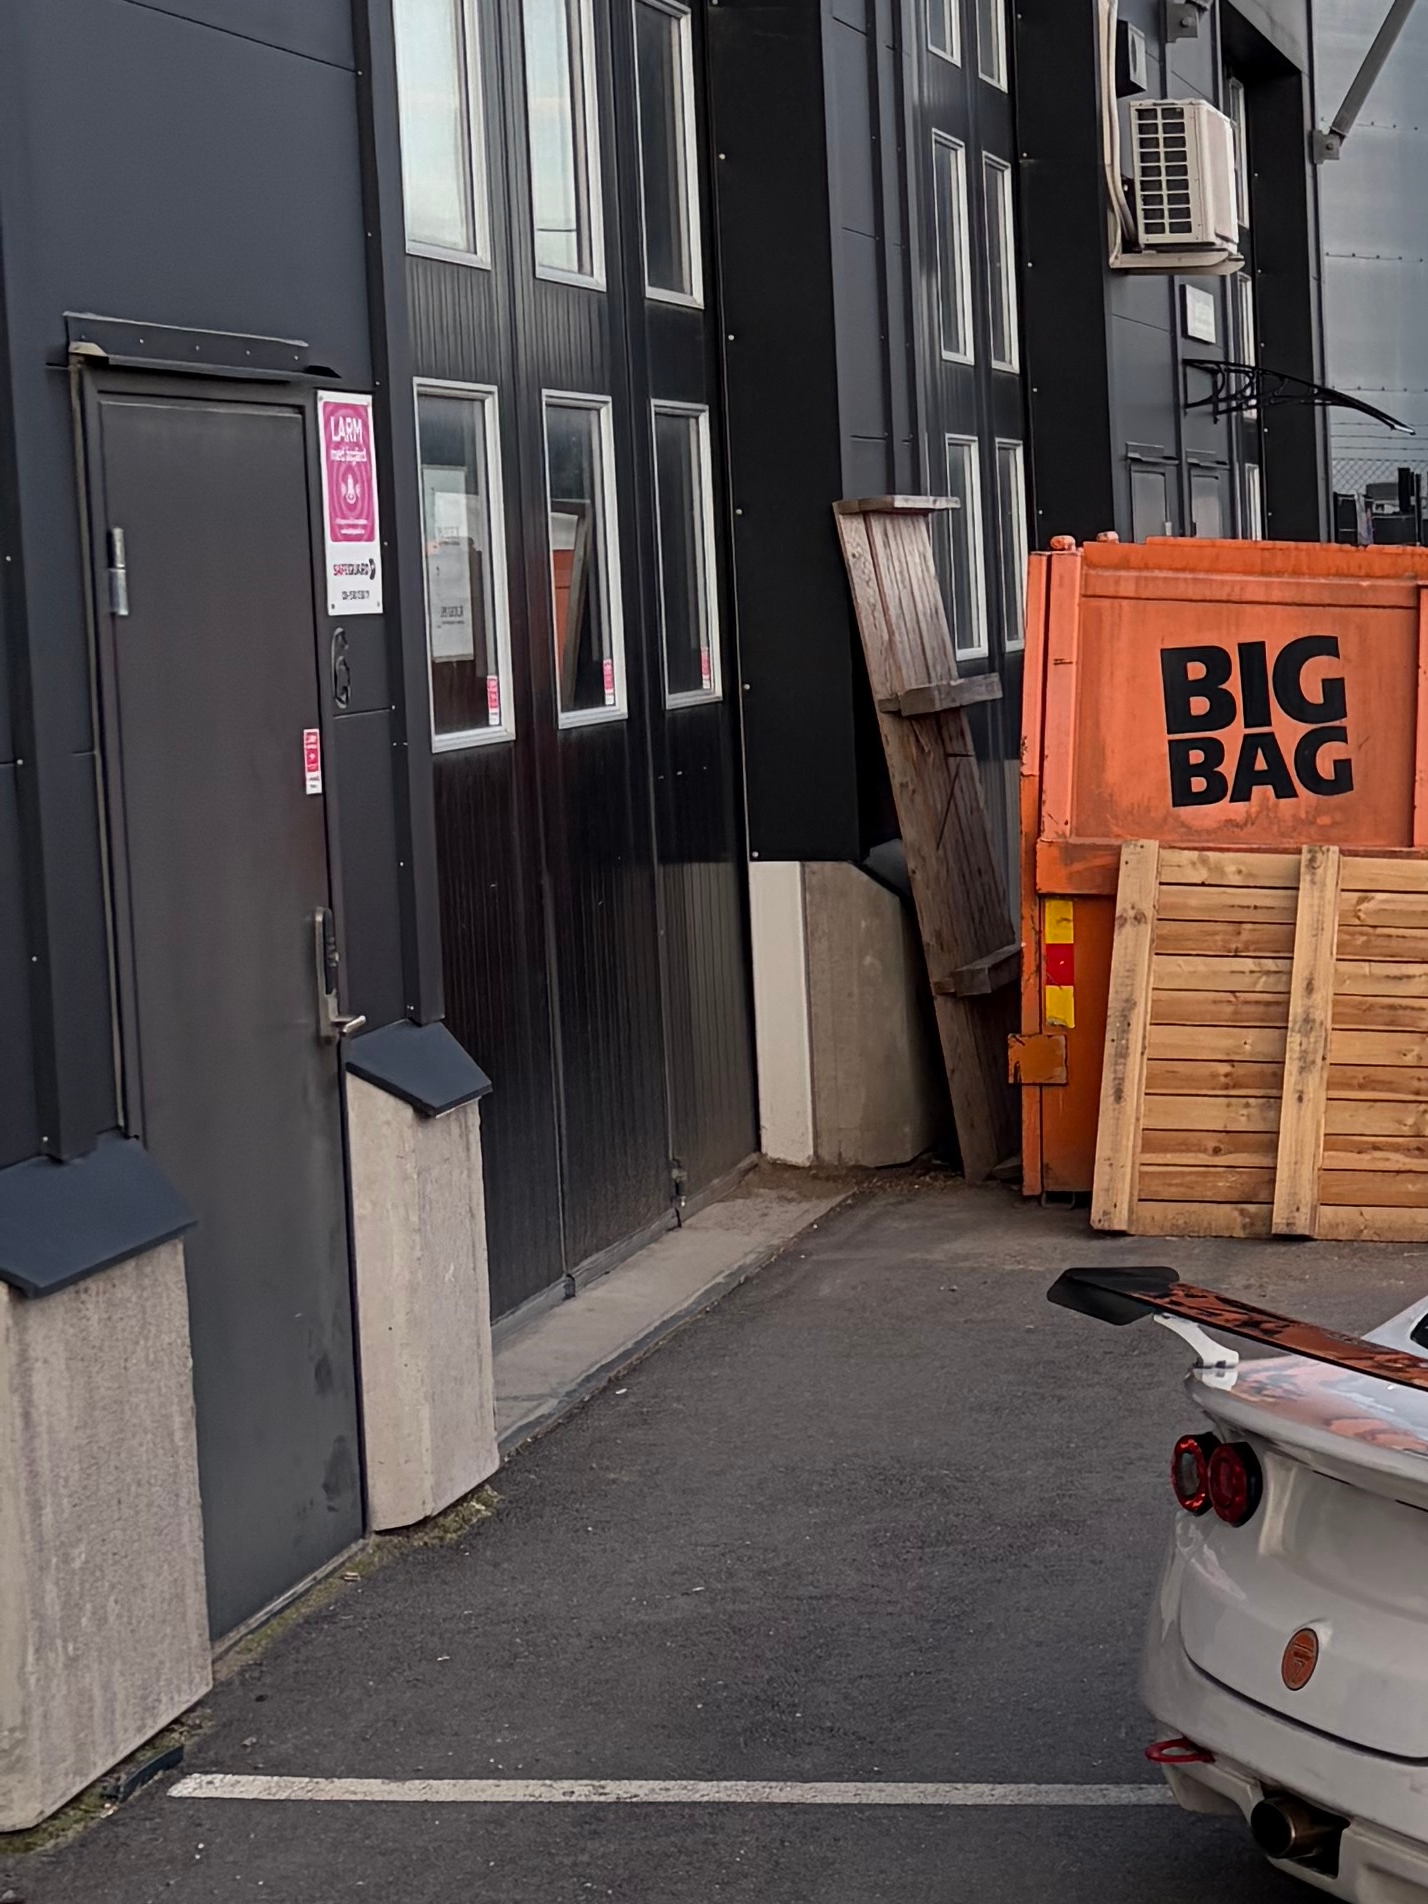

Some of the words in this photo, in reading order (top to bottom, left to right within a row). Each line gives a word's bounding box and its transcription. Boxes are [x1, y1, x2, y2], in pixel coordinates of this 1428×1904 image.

[330, 416, 363, 443] LARM
[1160, 635, 1347, 735] BIG
[1168, 726, 1354, 807] BAG
